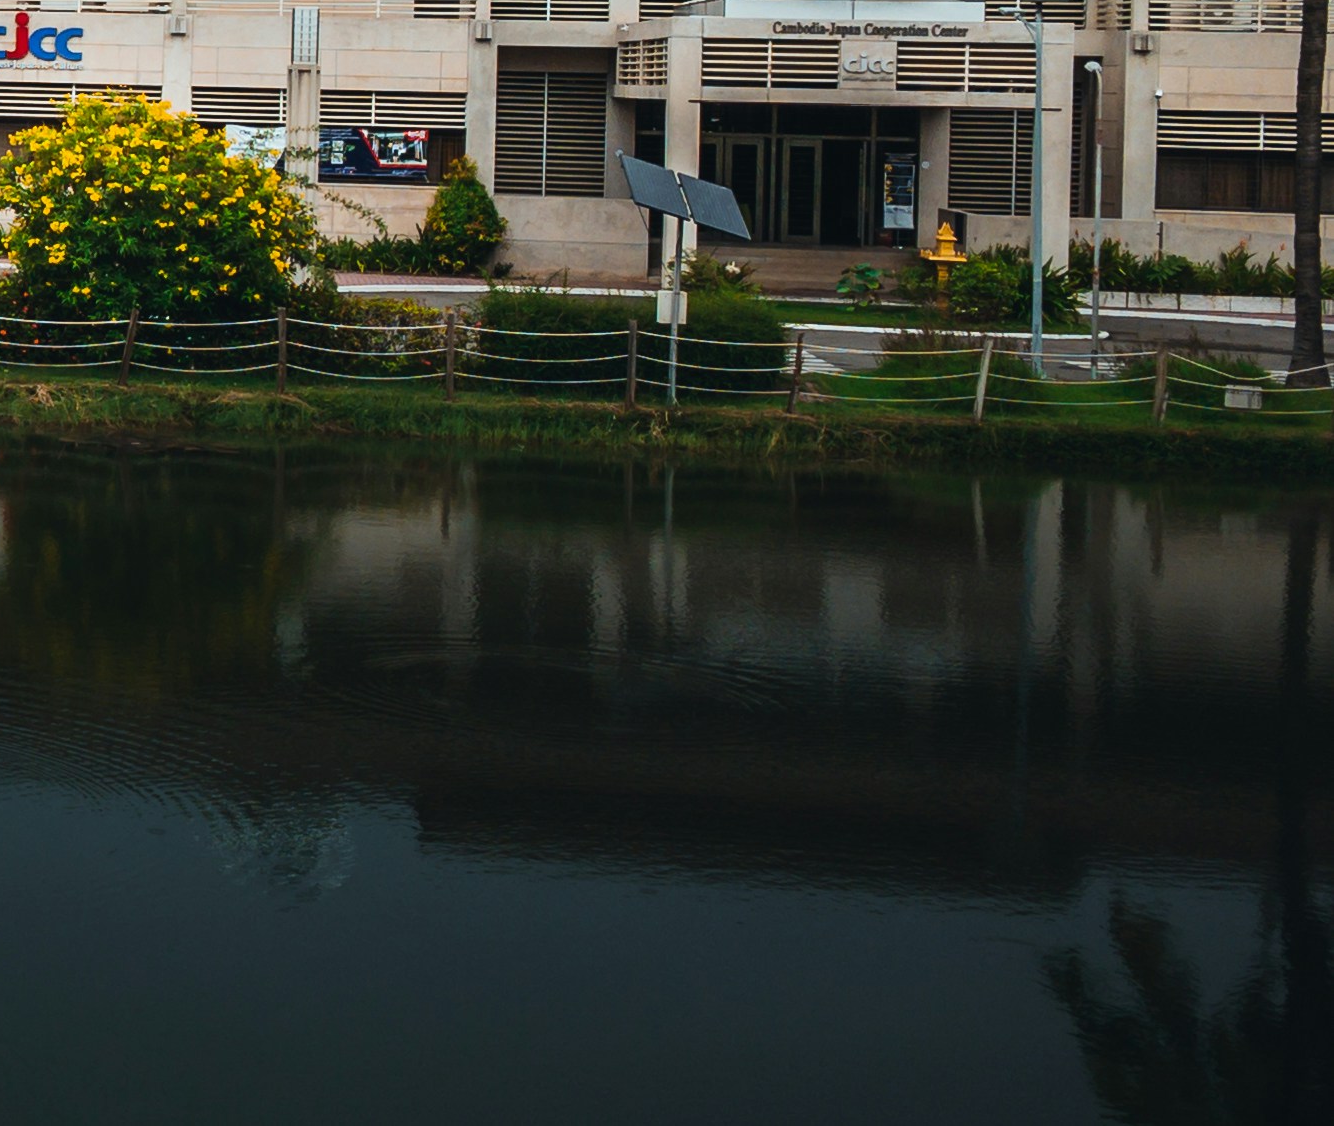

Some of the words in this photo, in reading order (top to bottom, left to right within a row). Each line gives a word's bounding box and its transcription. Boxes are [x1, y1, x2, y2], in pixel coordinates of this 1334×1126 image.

[772, 21, 861, 38] Cambodia-Japan
[864, 23, 929, 39] Cooperation
[931, 24, 969, 37] Center
